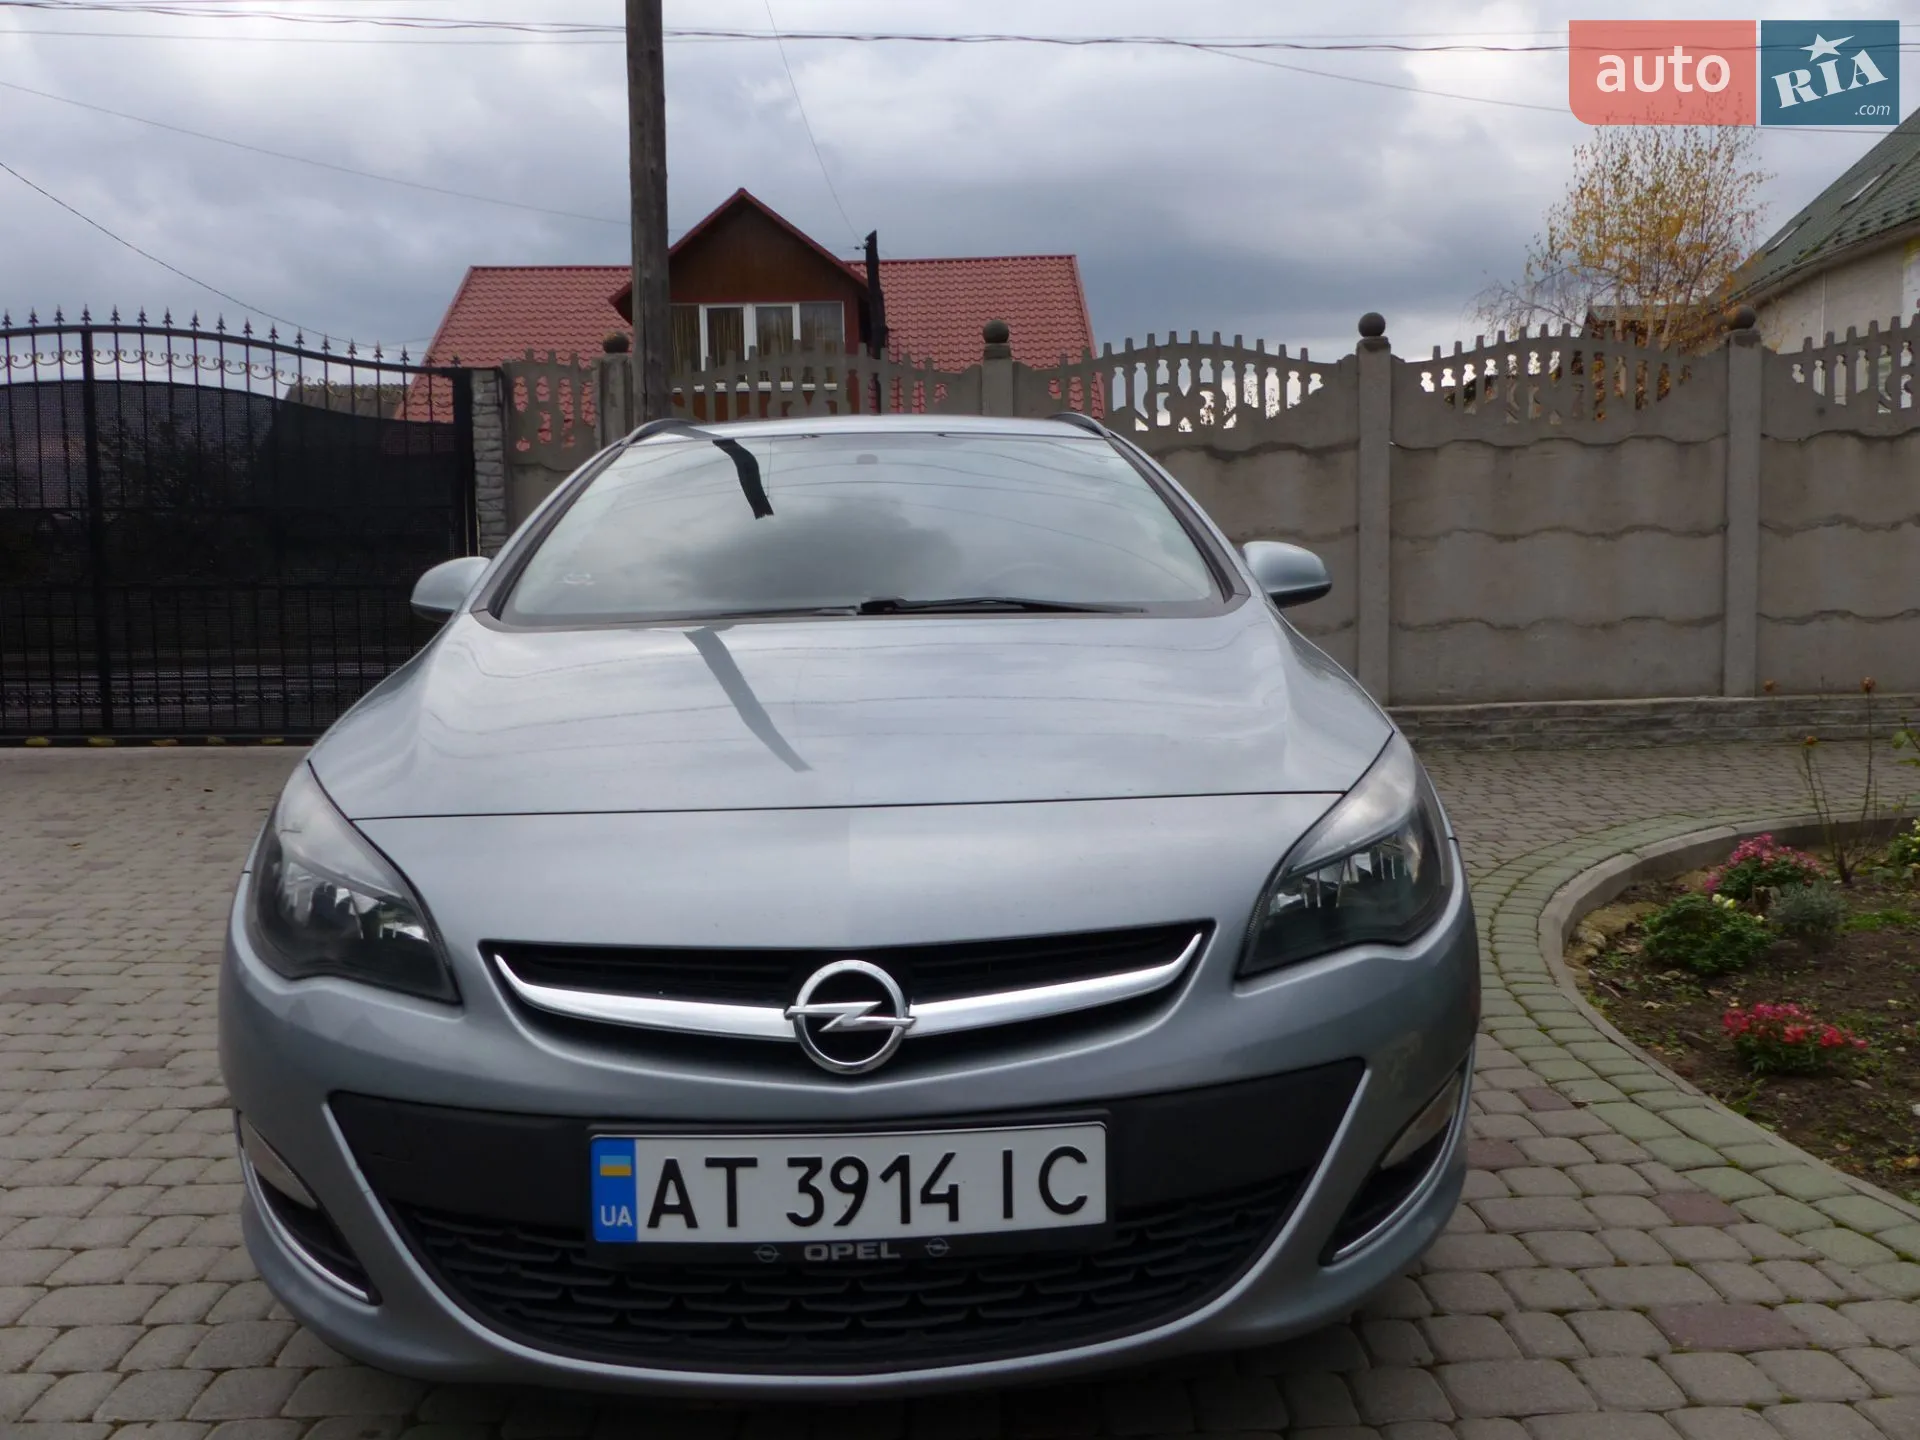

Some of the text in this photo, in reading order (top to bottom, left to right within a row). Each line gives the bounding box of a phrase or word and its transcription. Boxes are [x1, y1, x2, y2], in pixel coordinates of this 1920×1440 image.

[647, 1146, 1088, 1228] AT 3914 IC
[600, 1205, 633, 1227] UA
[804, 1242, 900, 1261] OPEL
